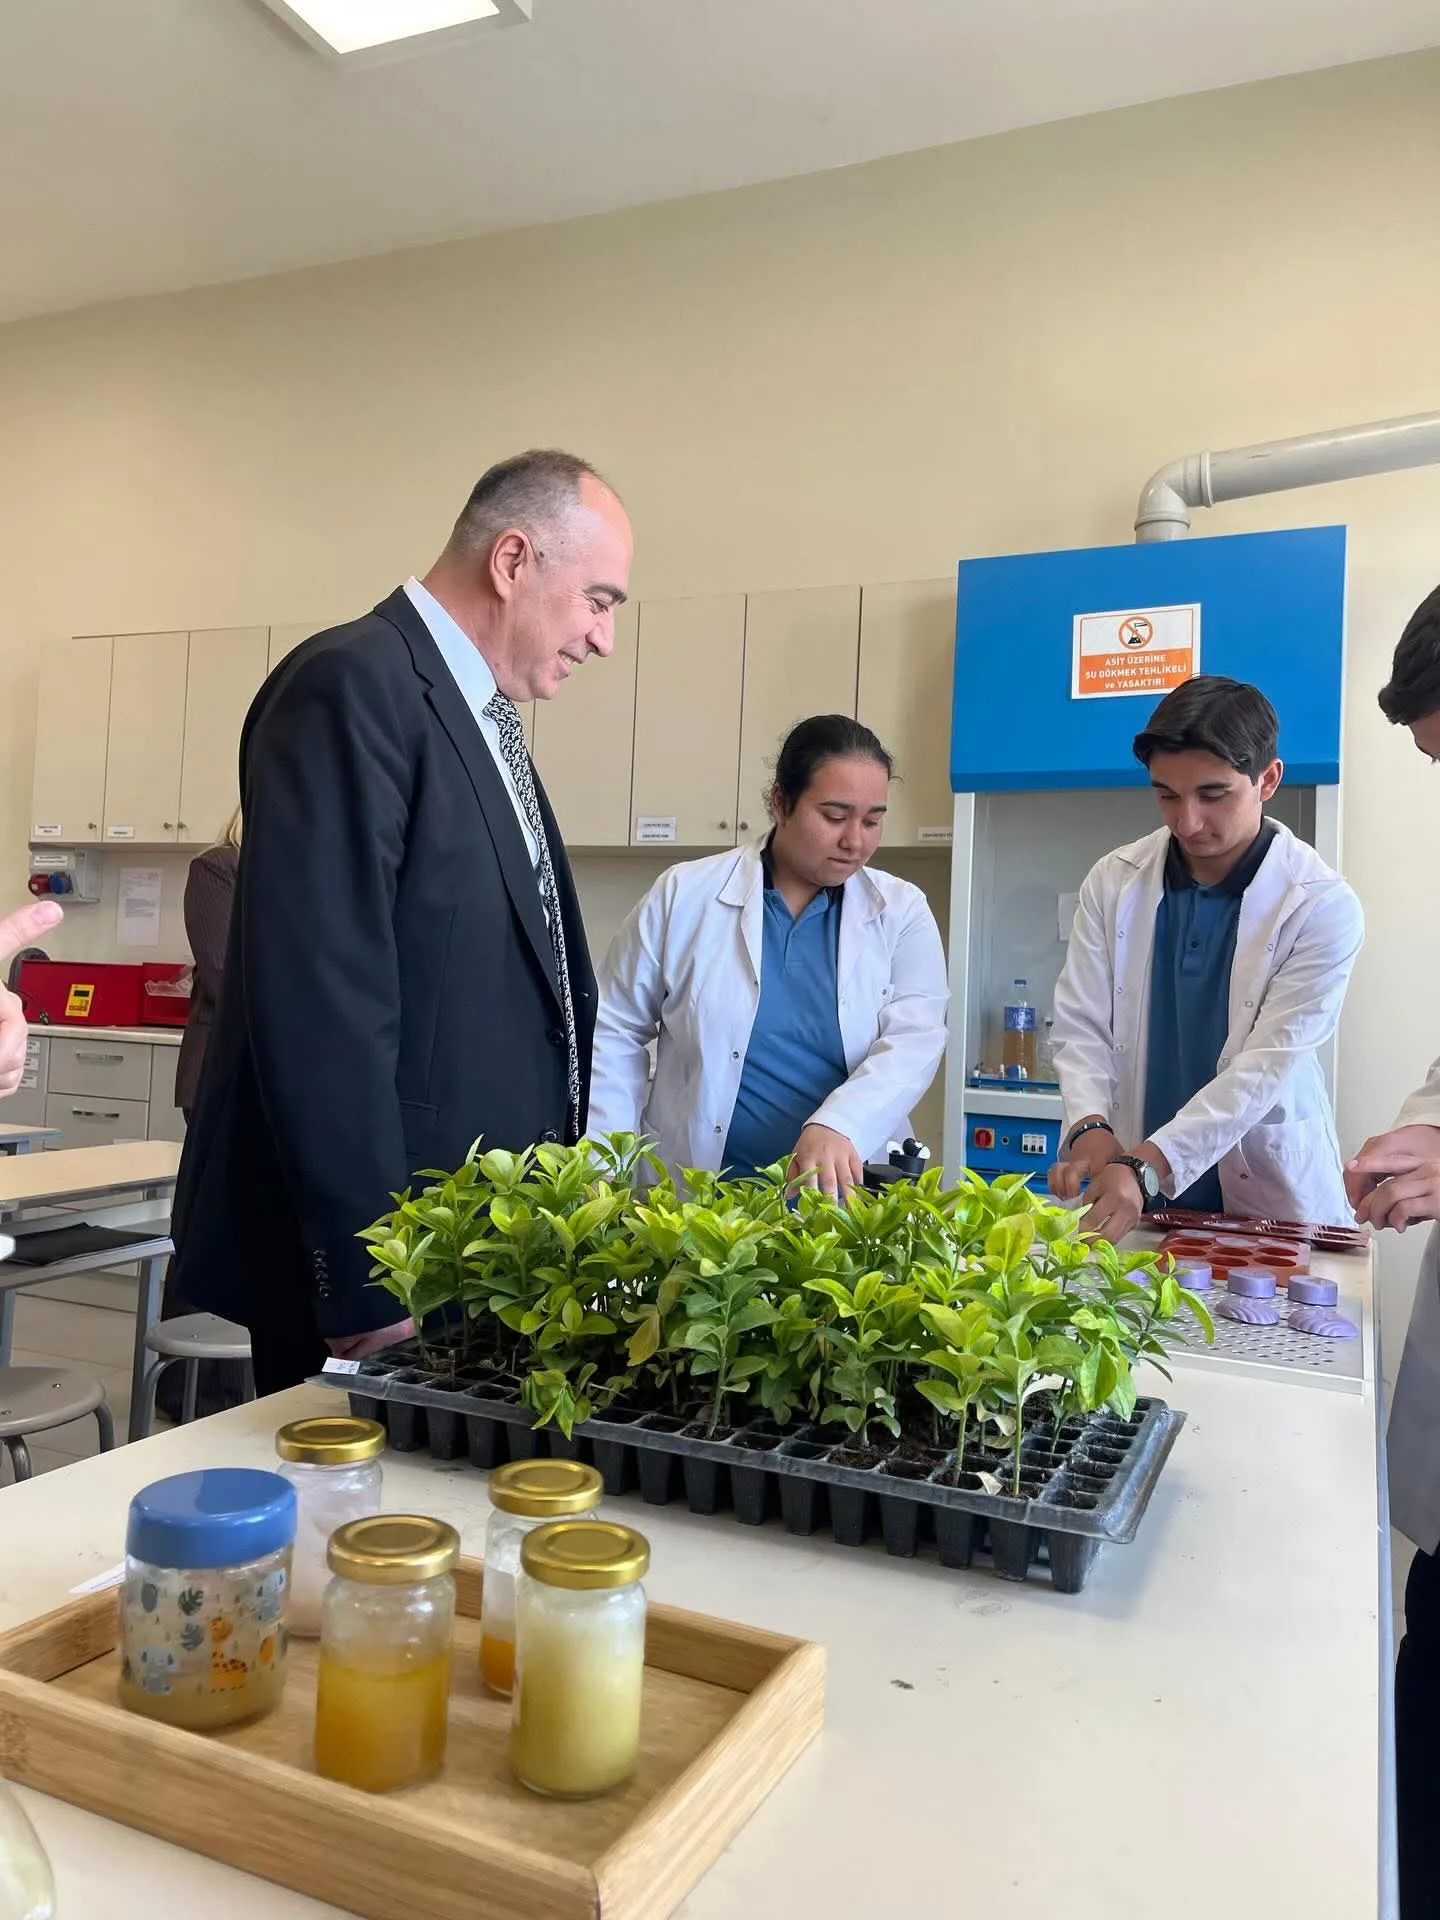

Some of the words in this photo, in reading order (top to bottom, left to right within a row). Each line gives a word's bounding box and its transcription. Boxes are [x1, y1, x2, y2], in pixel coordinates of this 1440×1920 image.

[1105, 656, 1125, 666] ASİT
[1127, 654, 1166, 664] ÜZERİNE
[1085, 671, 1097, 679] SU
[1099, 668, 1137, 678] DÖKMEK
[1139, 664, 1186, 674] TEHLİKELİ
